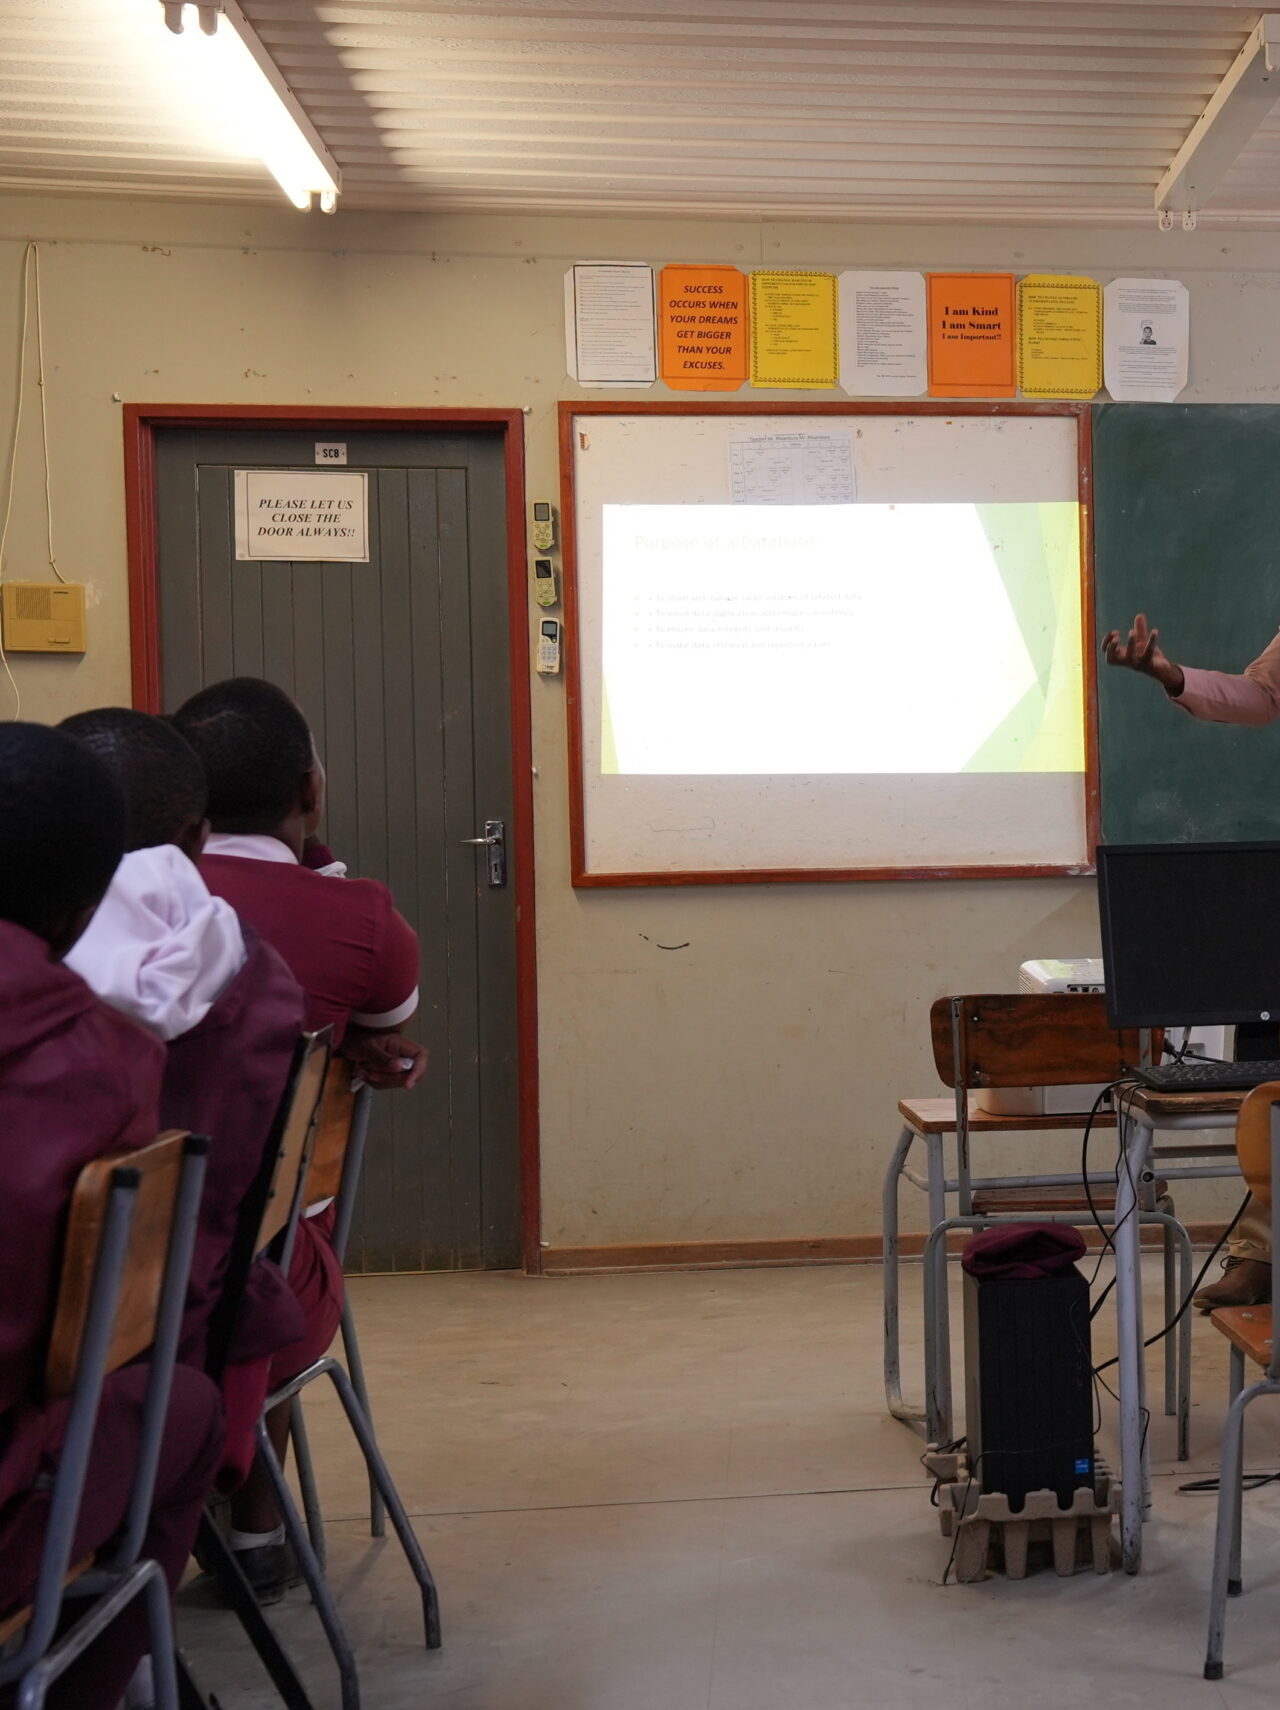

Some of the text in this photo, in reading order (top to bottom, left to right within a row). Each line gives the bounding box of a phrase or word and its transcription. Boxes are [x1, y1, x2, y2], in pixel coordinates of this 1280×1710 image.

[684, 285, 724, 294] SUCCESS
[669, 300, 738, 309] OCCURS WHEN
[945, 306, 949, 316] I
[972, 306, 998, 316] Kind
[670, 315, 738, 325] YOUR DREAMS
[942, 320, 946, 329] I
[969, 321, 1001, 330] Smart
[676, 330, 732, 339] GET BIGGER
[677, 345, 732, 355] THAN YOUR
[683, 361, 725, 370] EXCUSES.
[258, 499, 353, 510] PLEASE LET US
[271, 513, 341, 523] CLOSE THE
[257, 526, 355, 538] DOOR ALWAYS!!
[635, 534, 816, 551] Purpose of a Database
